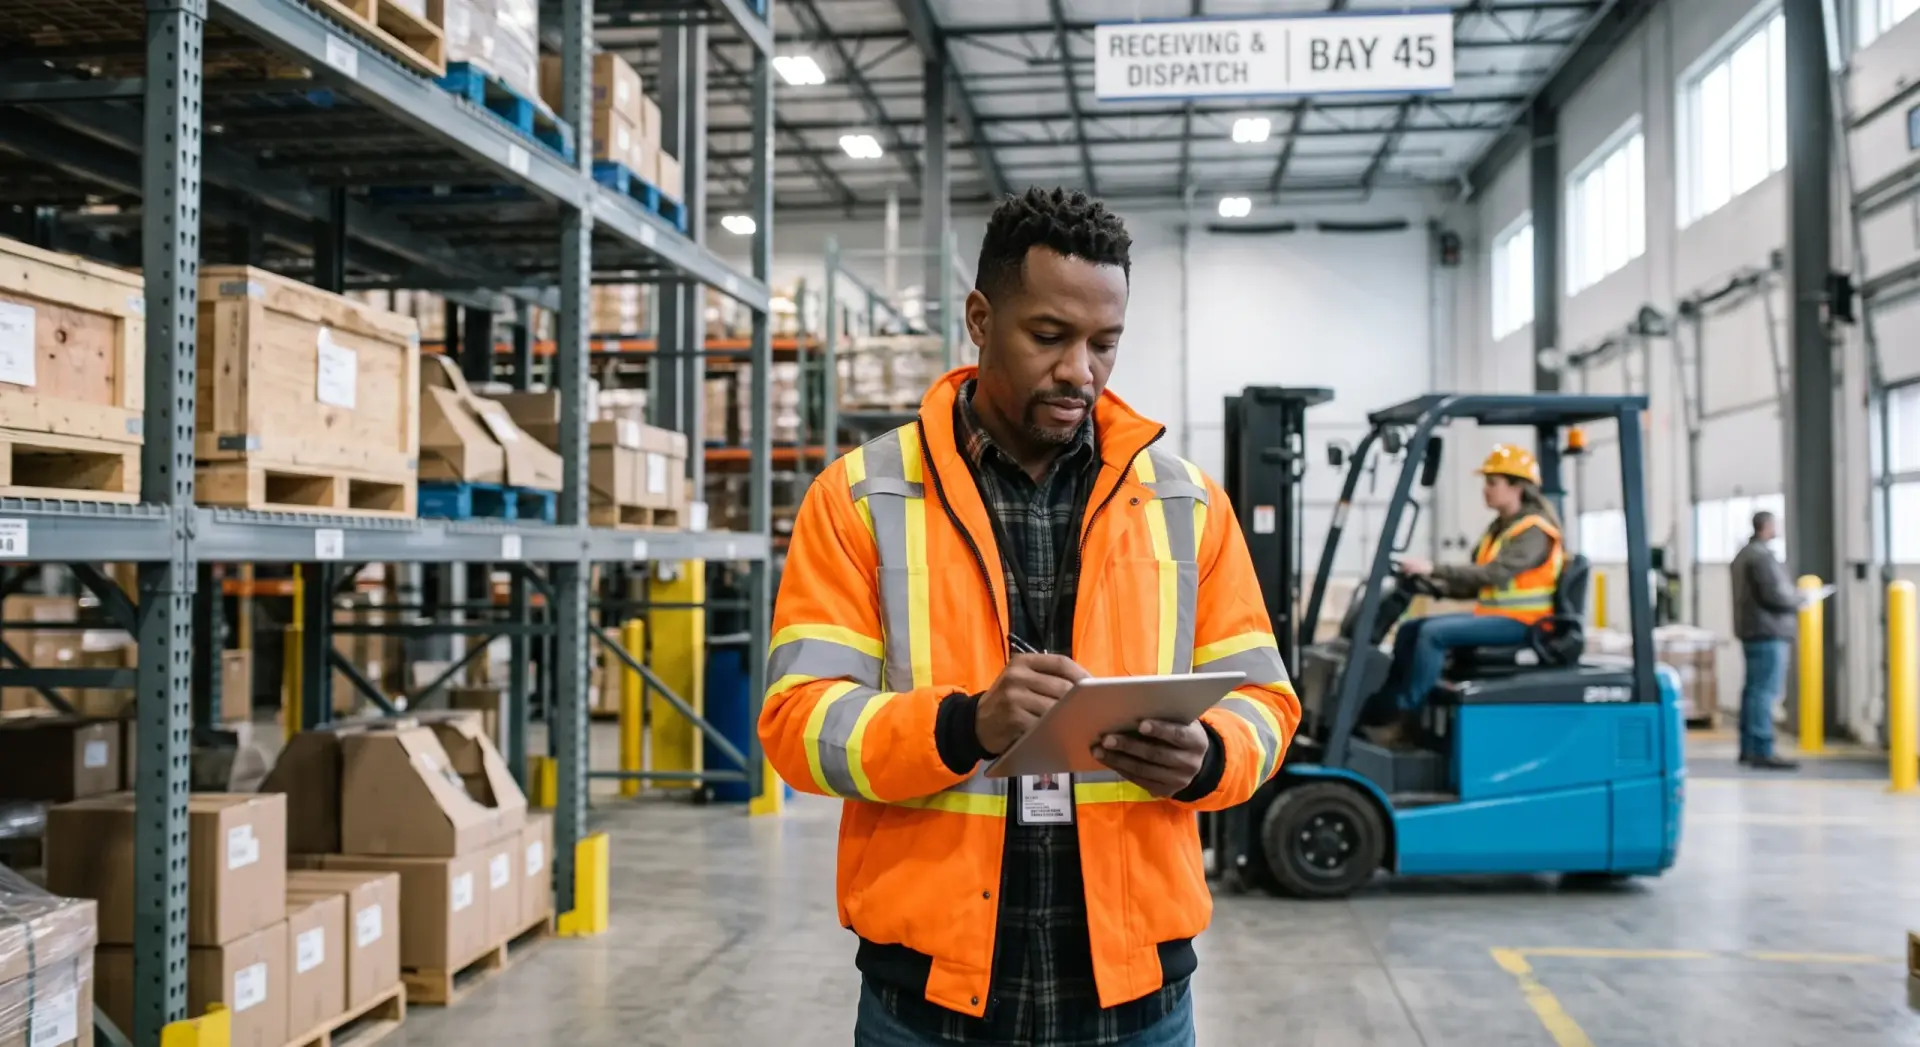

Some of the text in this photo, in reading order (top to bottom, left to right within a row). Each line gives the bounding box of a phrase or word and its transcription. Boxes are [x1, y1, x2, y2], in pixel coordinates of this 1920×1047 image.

[1109, 31, 1265, 57] RECEIVING &
[1311, 35, 1435, 70] BAY 45
[1128, 61, 1248, 87] DISPATCH
